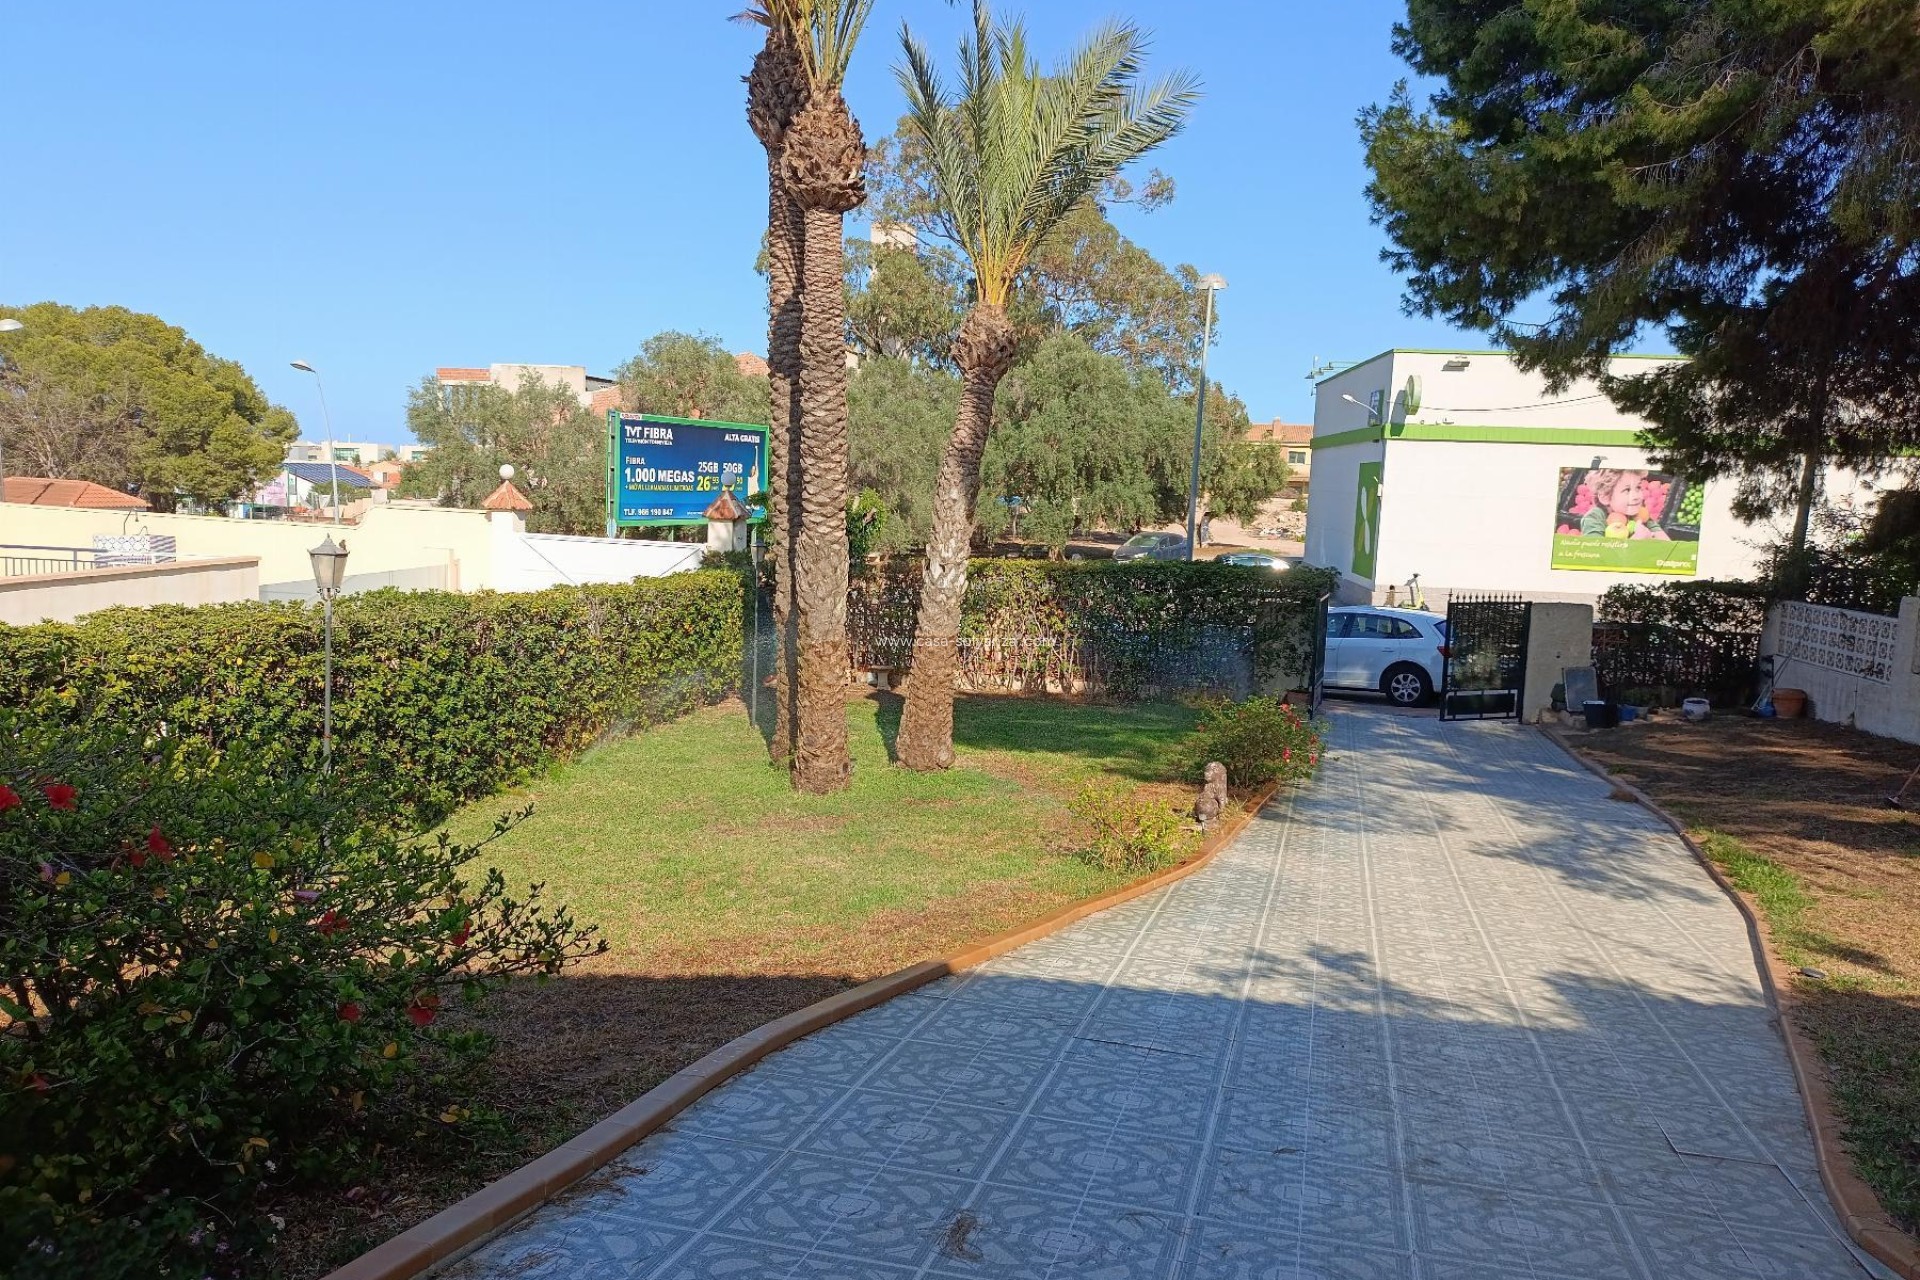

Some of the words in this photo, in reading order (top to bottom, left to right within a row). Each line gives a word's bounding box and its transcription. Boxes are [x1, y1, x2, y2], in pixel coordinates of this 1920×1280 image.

[625, 425, 642, 438] TVT
[644, 427, 673, 440] FIBRA
[724, 433, 739, 442] ALTA
[740, 435, 760, 443] GRATIS
[626, 456, 645, 465] FIBRA
[698, 461, 718, 473] 25GB
[723, 463, 742, 474] 50GB
[625, 467, 656, 482] 1.000
[658, 469, 695, 483] MEGAS
